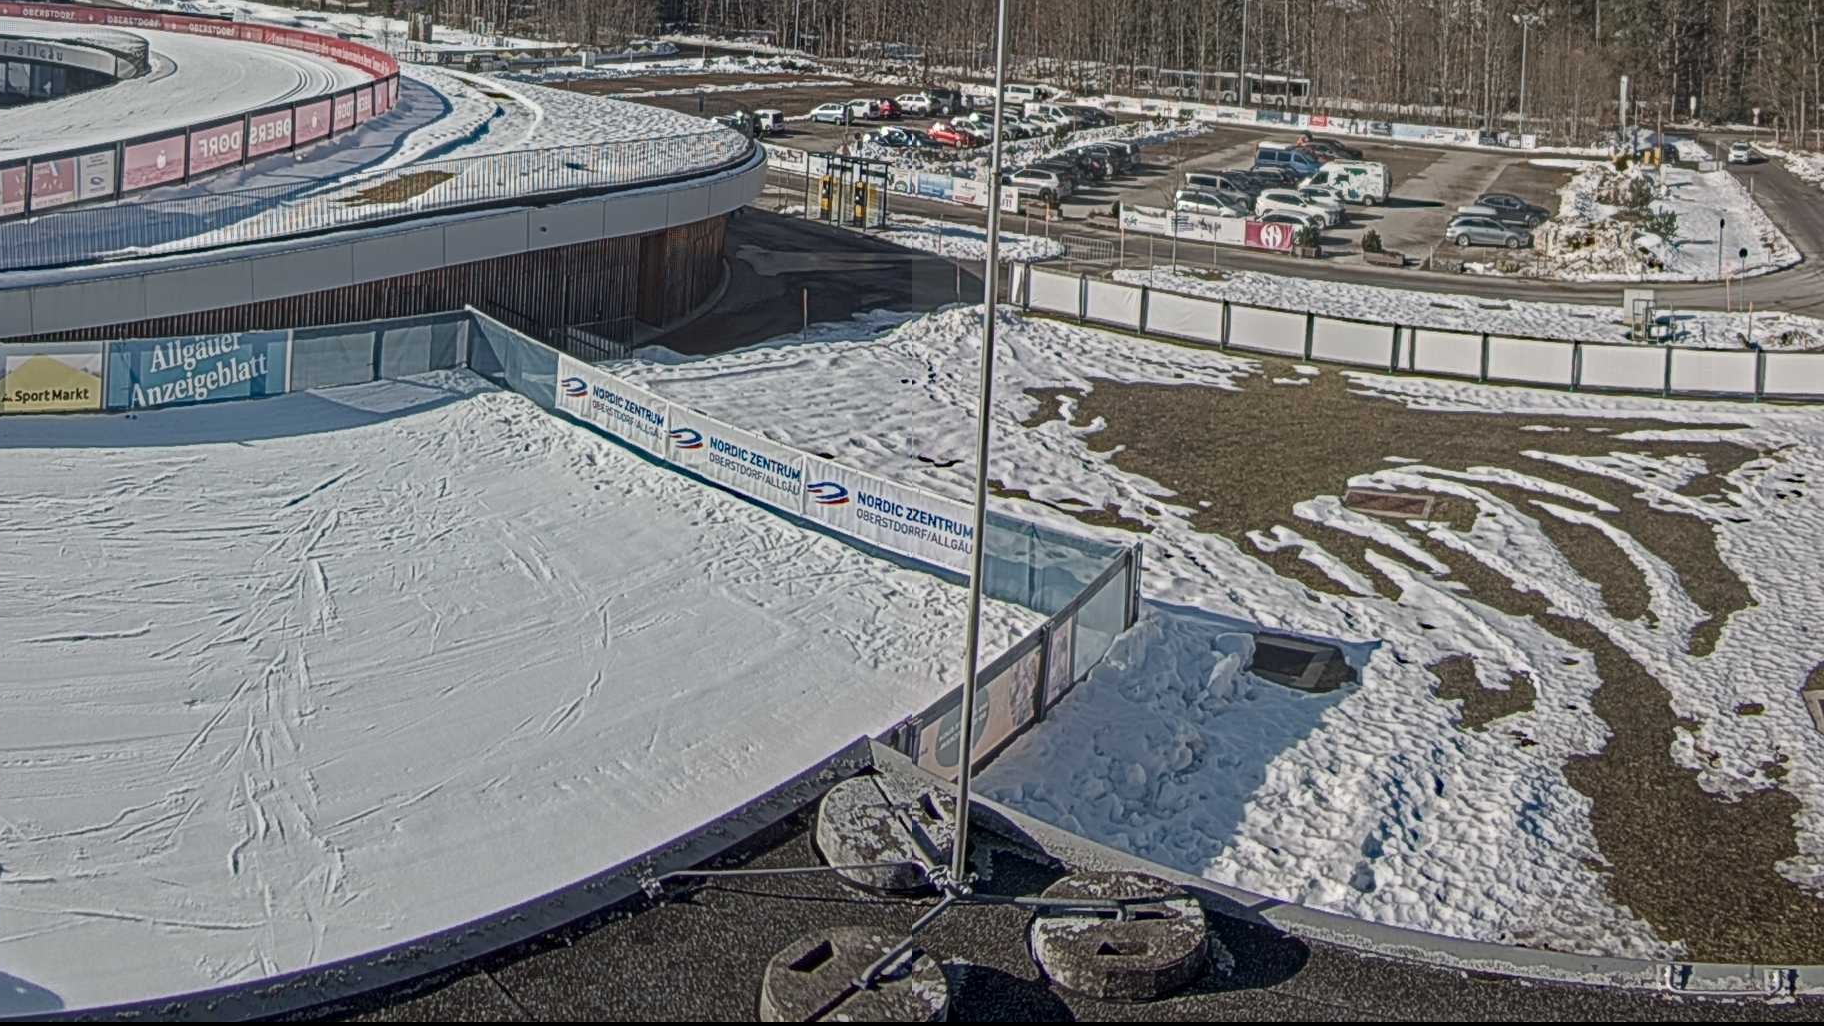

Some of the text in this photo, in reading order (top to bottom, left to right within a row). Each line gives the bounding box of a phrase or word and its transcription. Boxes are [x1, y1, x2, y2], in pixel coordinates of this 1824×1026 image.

[149, 332, 242, 373] Allgäuer
[131, 352, 269, 408] Anzeigeblatt
[592, 384, 665, 427] NORDIC ZENTRUM
[710, 436, 801, 482] NORDIC ZENTRUM
[857, 491, 904, 517] NORDIC
